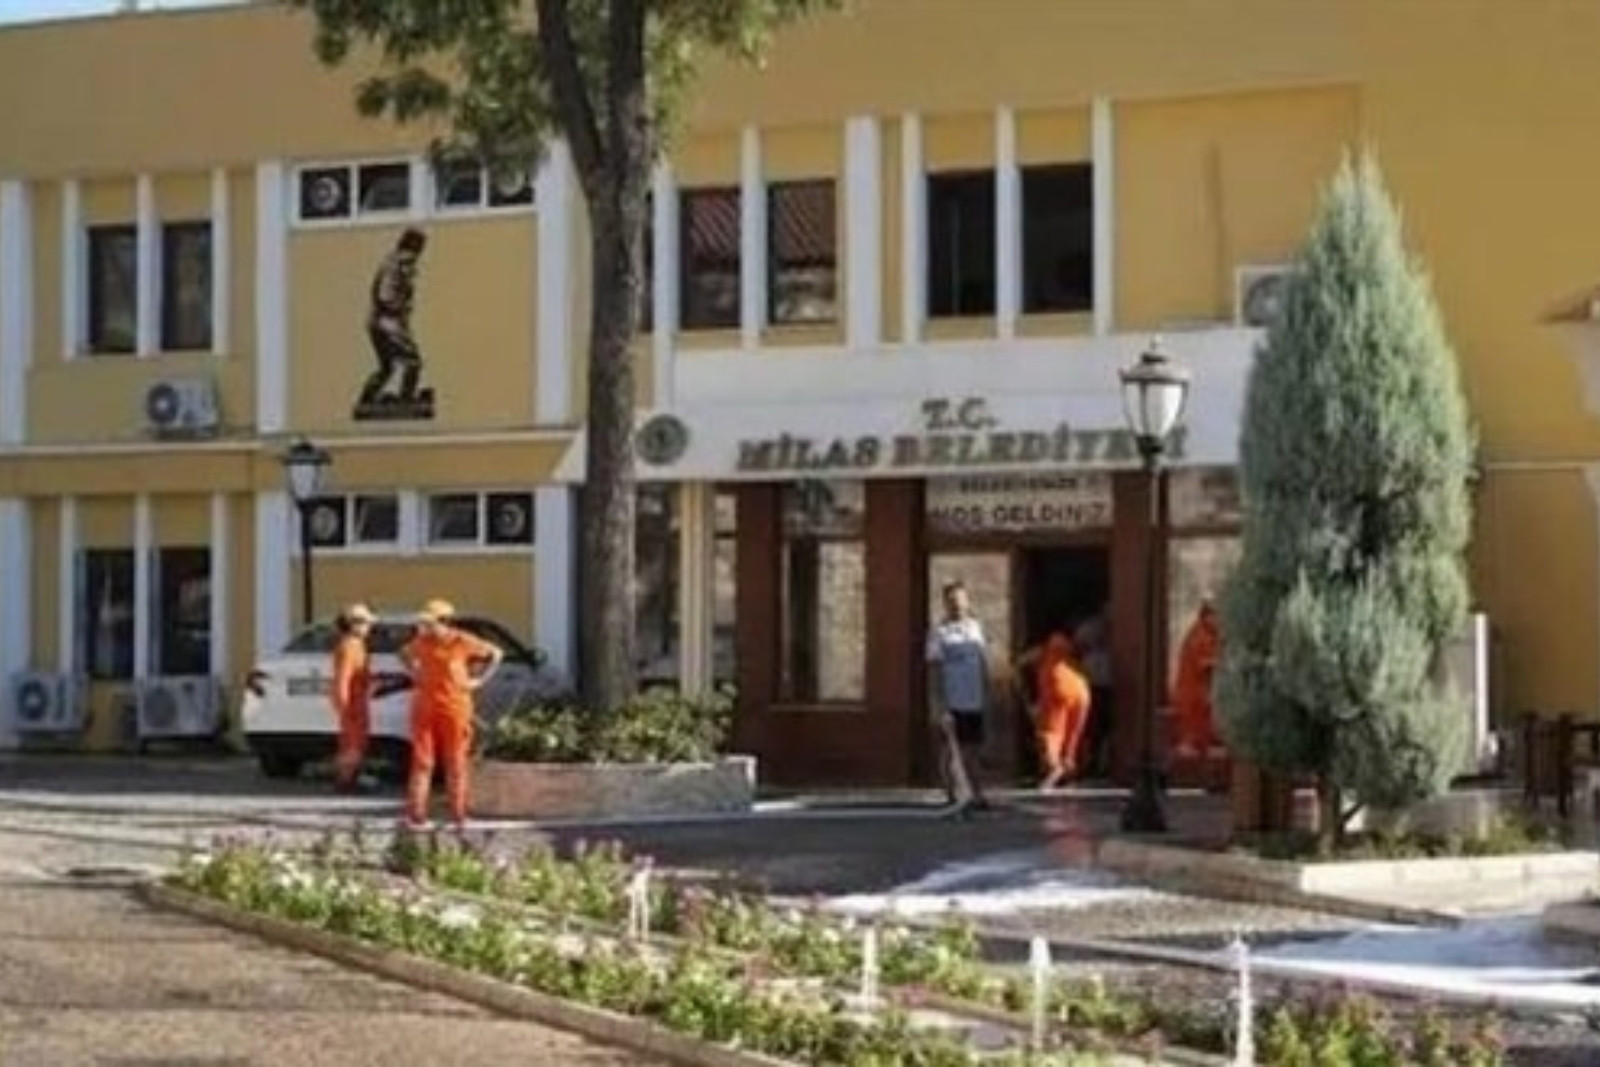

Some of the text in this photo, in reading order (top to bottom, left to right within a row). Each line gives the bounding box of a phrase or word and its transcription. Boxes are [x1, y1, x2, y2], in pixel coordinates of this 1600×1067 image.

[922, 397, 997, 431] T.C.
[737, 421, 1187, 470] MİLAS BELEDİYEİ
